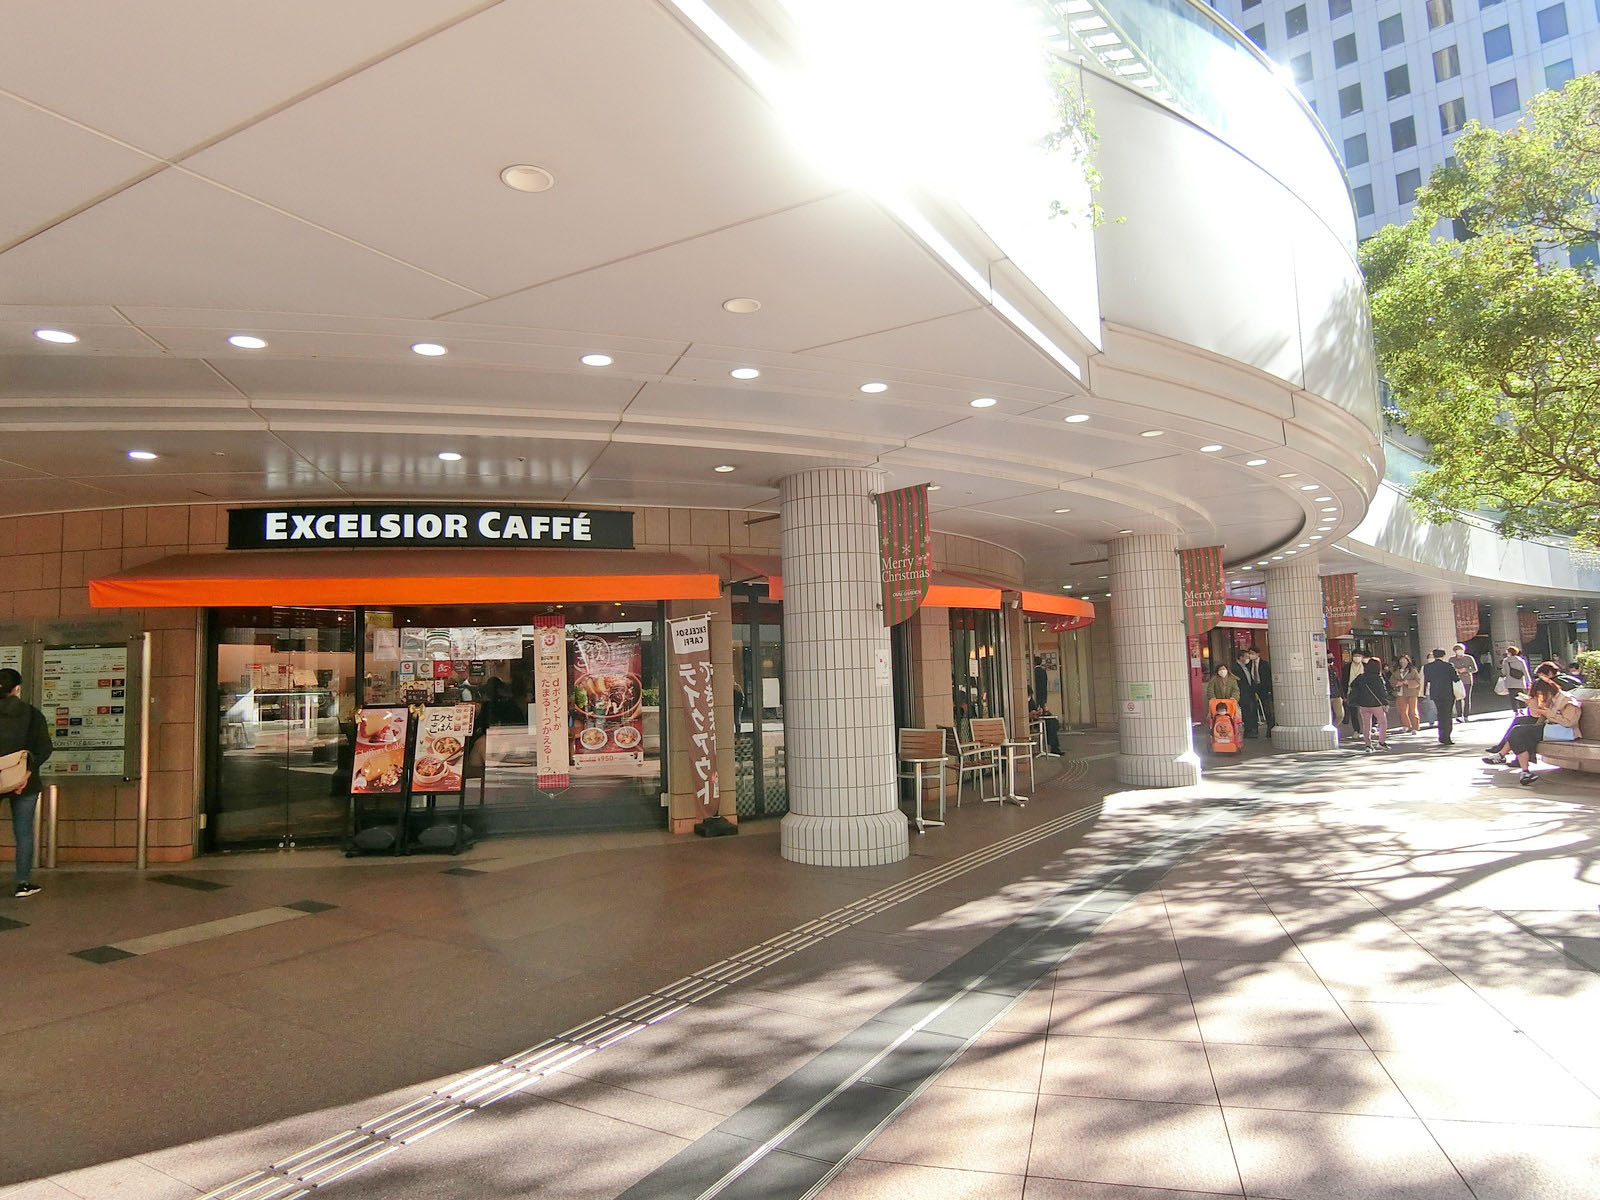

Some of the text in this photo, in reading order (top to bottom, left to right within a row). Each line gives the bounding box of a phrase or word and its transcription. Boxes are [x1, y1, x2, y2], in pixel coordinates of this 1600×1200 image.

[264, 511, 592, 541] EXCELSIOR CAFFÉ
[882, 556, 914, 571] Merry
[882, 569, 930, 583] Christmas
[1184, 591, 1212, 600] Merry
[1184, 598, 1225, 608] Christmas
[552, 678, 562, 731] dポイントが
[430, 714, 454, 722] エクセ
[429, 722, 453, 734] ごはん
[384, 742, 406, 752] Cake
